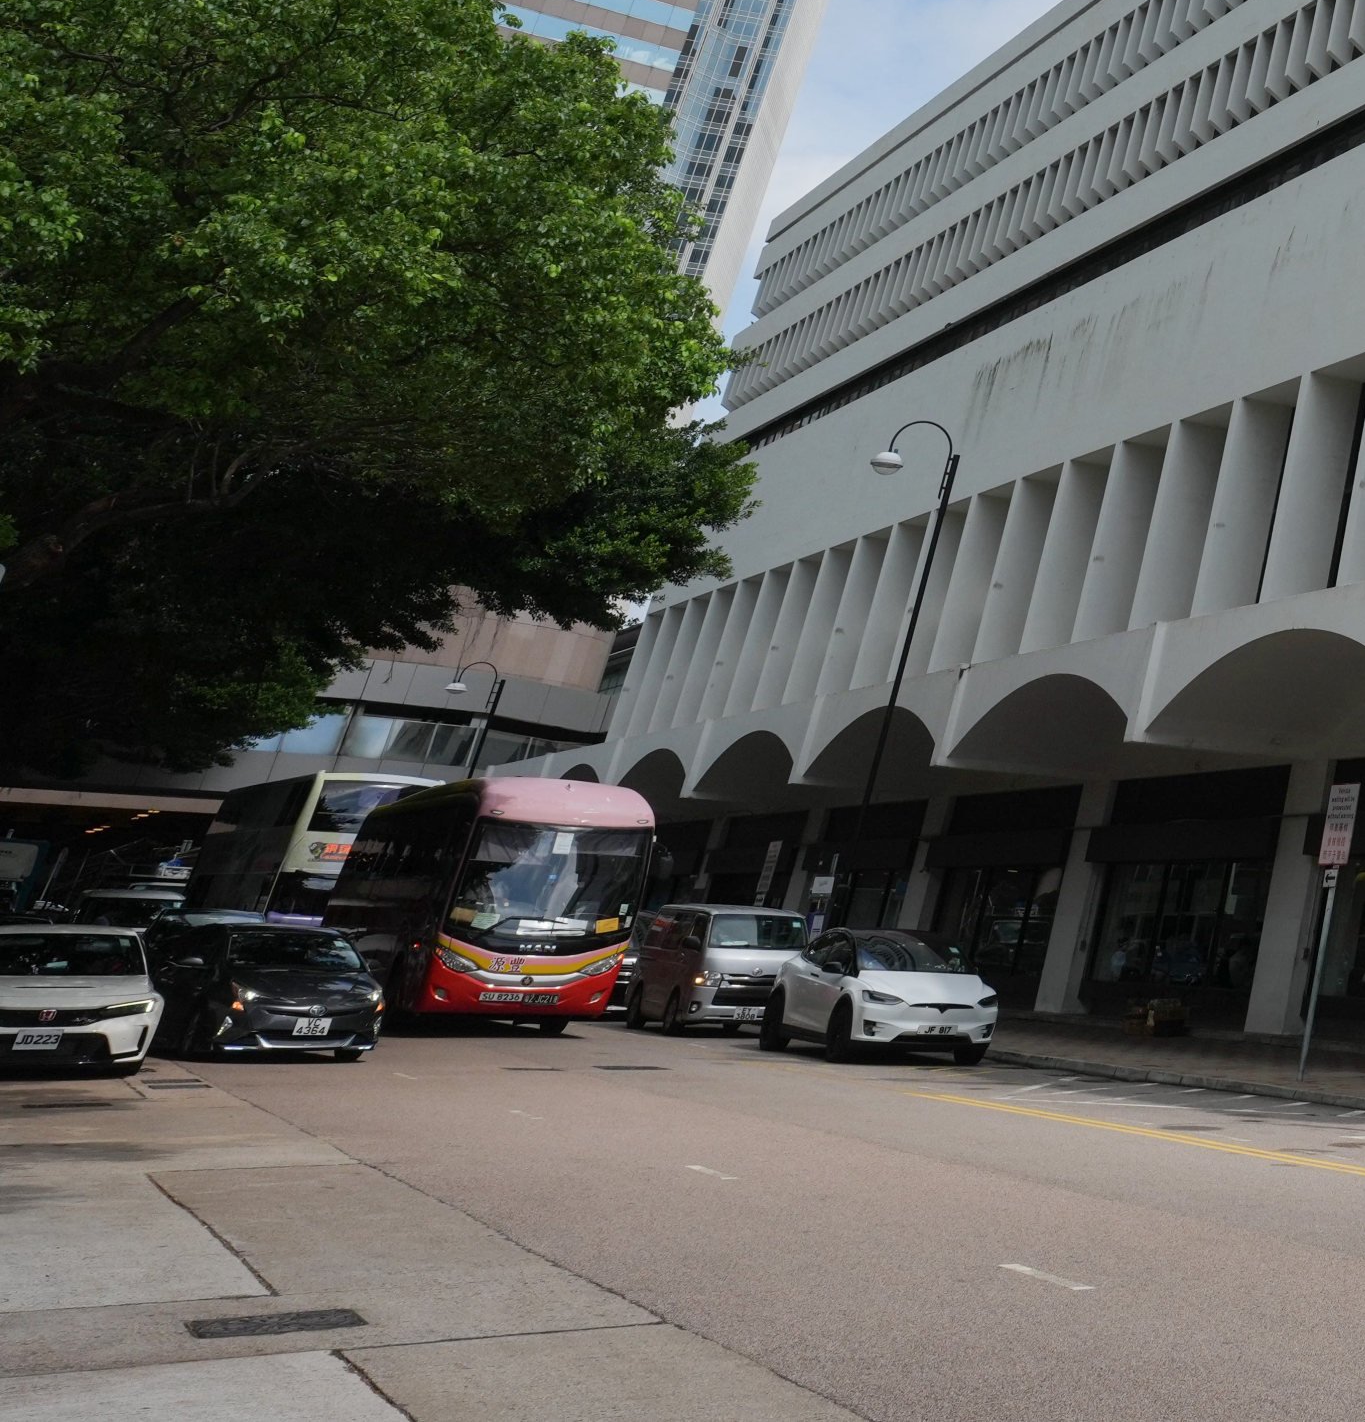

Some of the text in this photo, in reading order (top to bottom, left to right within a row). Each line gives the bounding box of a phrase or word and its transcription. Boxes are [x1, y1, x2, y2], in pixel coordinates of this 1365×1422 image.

[520, 944, 557, 953] MAN
[497, 993, 520, 1001] 8236
[308, 1018, 322, 1027] VC
[296, 1026, 326, 1035] 4364
[924, 1026, 952, 1034] JF 817
[15, 1034, 61, 1045] JD223
